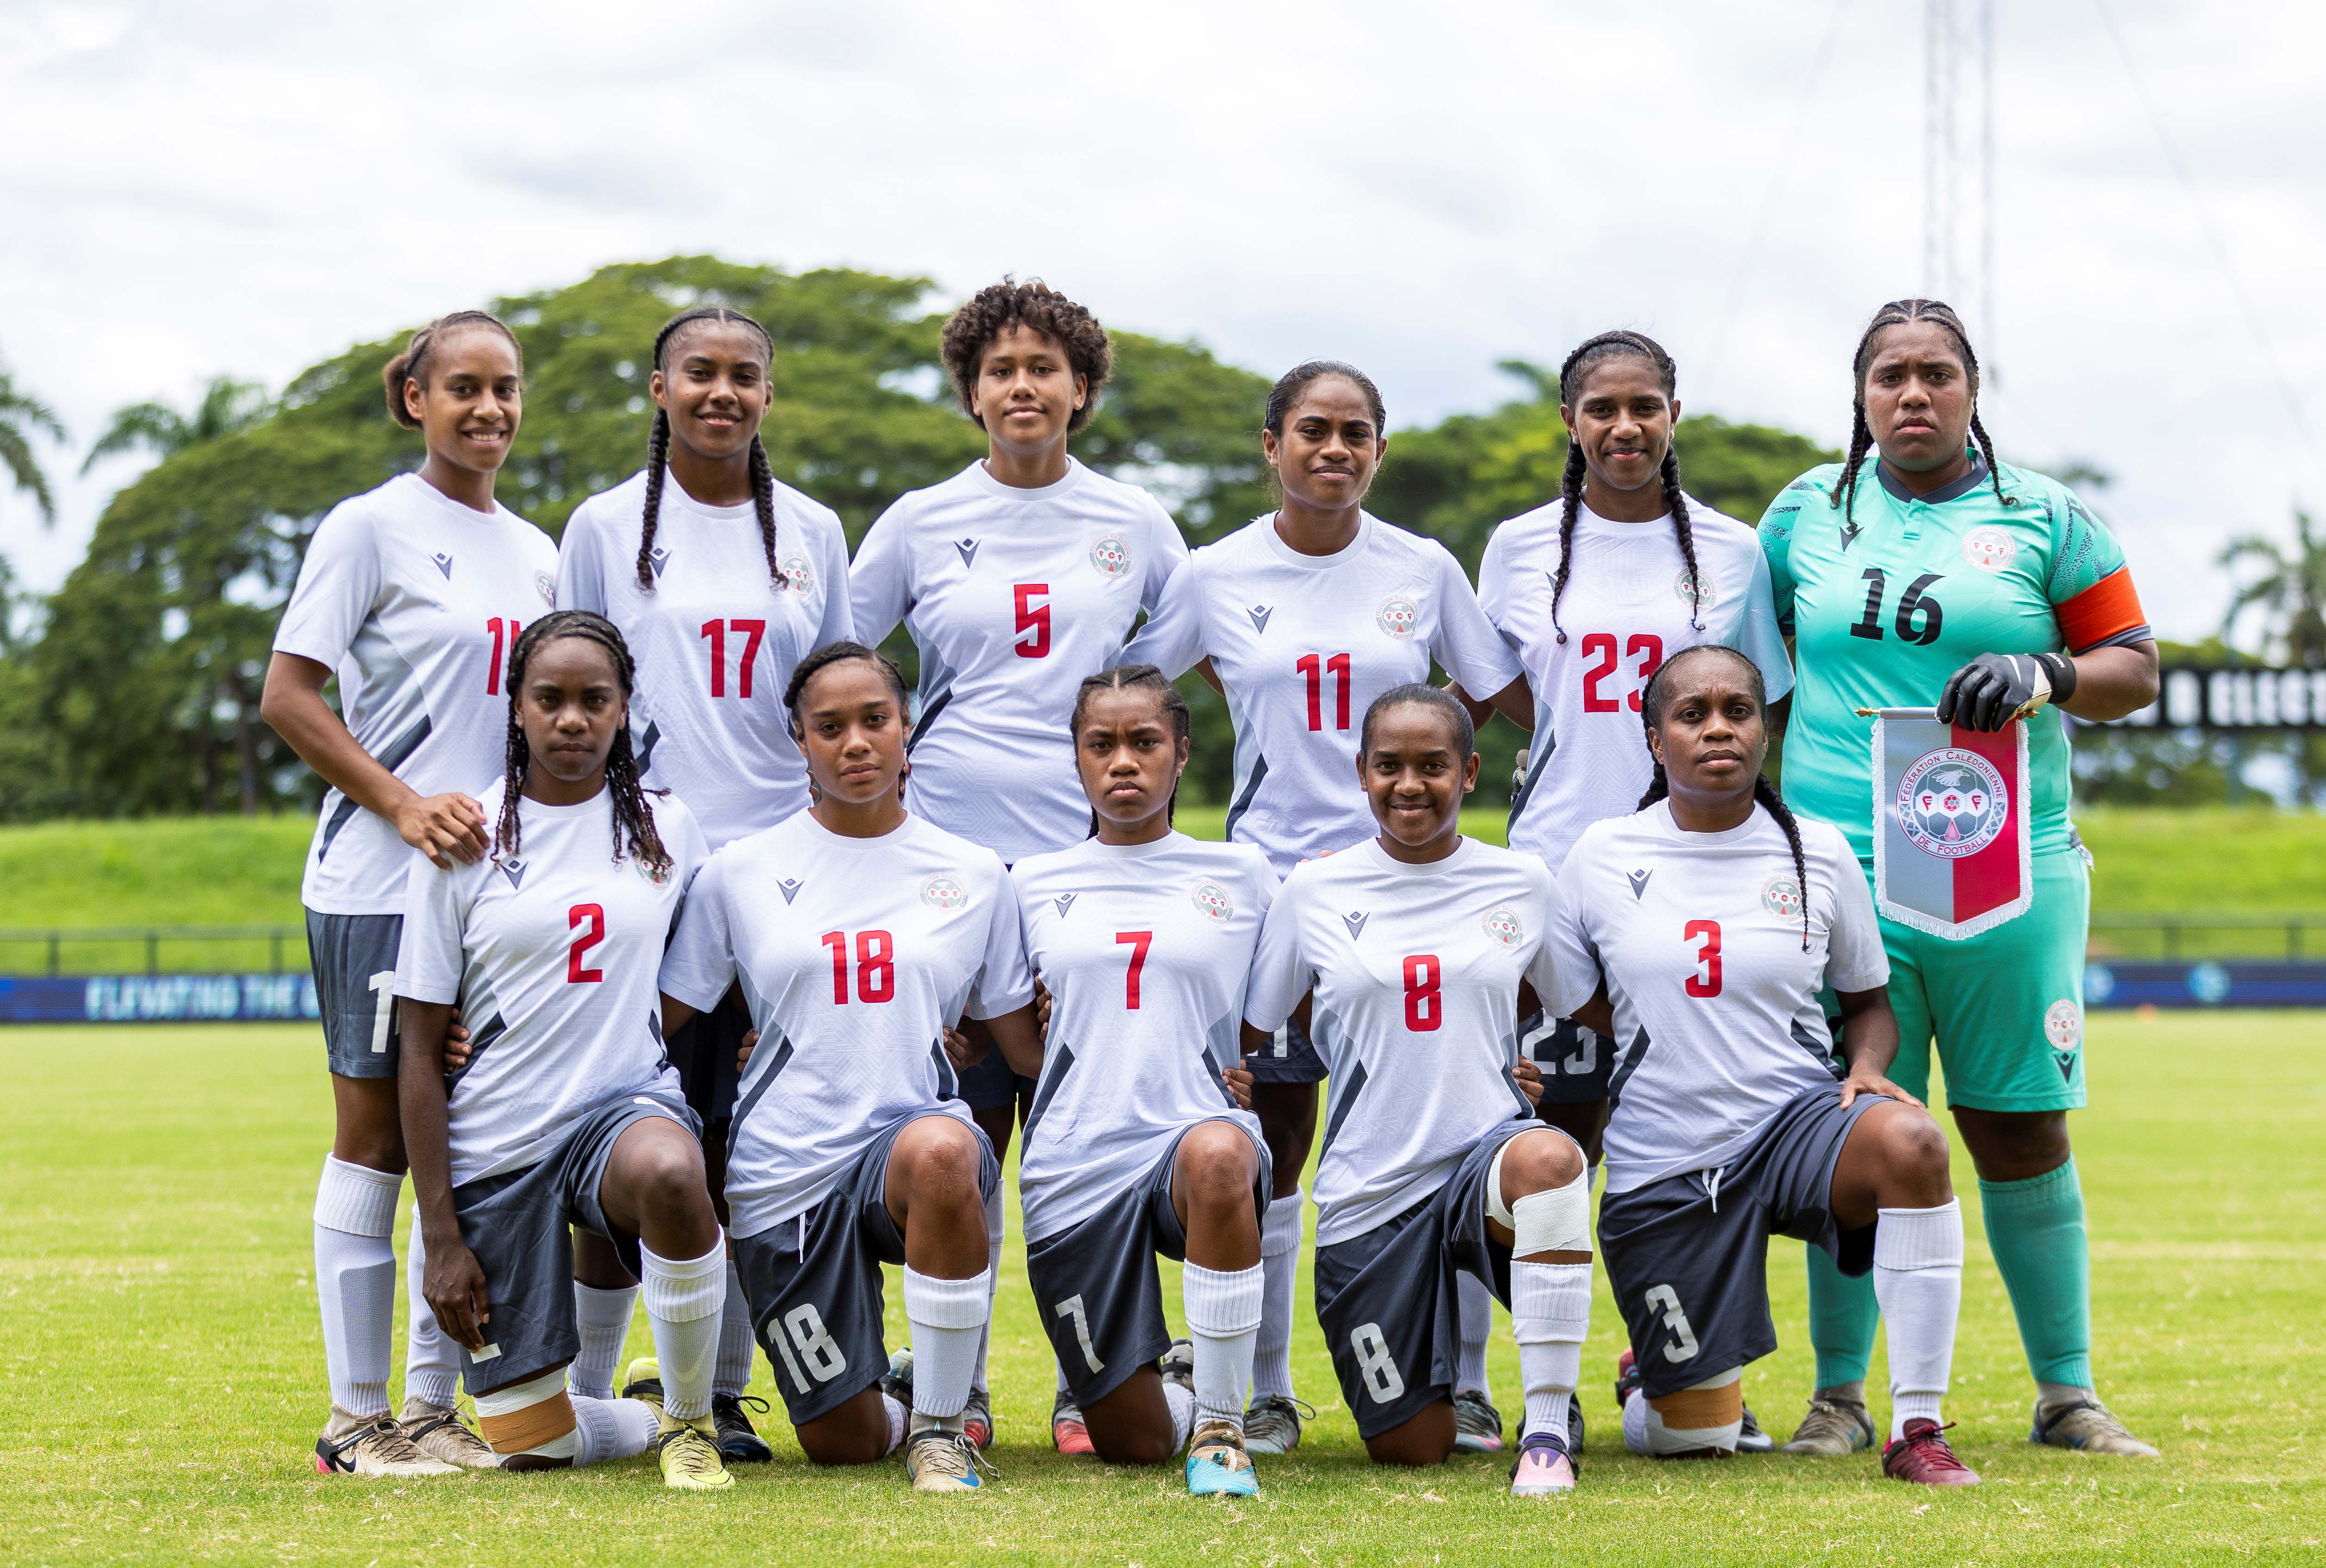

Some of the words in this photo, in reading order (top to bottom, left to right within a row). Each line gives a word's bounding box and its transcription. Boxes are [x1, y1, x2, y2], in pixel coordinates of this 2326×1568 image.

[1013, 584, 1051, 658] 5
[1850, 568, 1945, 646] 16
[702, 619, 766, 699] 17
[1296, 653, 1350, 732] 11
[1582, 633, 1663, 713] 23
[1900, 755, 1941, 802] FÉDÉRATION
[1946, 751, 2003, 799] CALÉDONIENNE
[1917, 836, 1931, 849] DE
[1937, 836, 1988, 855] FOOTBALL
[568, 903, 605, 983] 2
[822, 930, 895, 1005] 18
[1116, 931, 1152, 1009] 7
[1684, 920, 1722, 998] 3
[1403, 954, 1442, 1032] 8
[766, 1304, 846, 1395] 18
[1055, 1294, 1105, 1374] 7
[1645, 1284, 1698, 1363] 3
[1351, 1322, 1404, 1404] 8
[338, 1433, 363, 1451] playermaker
